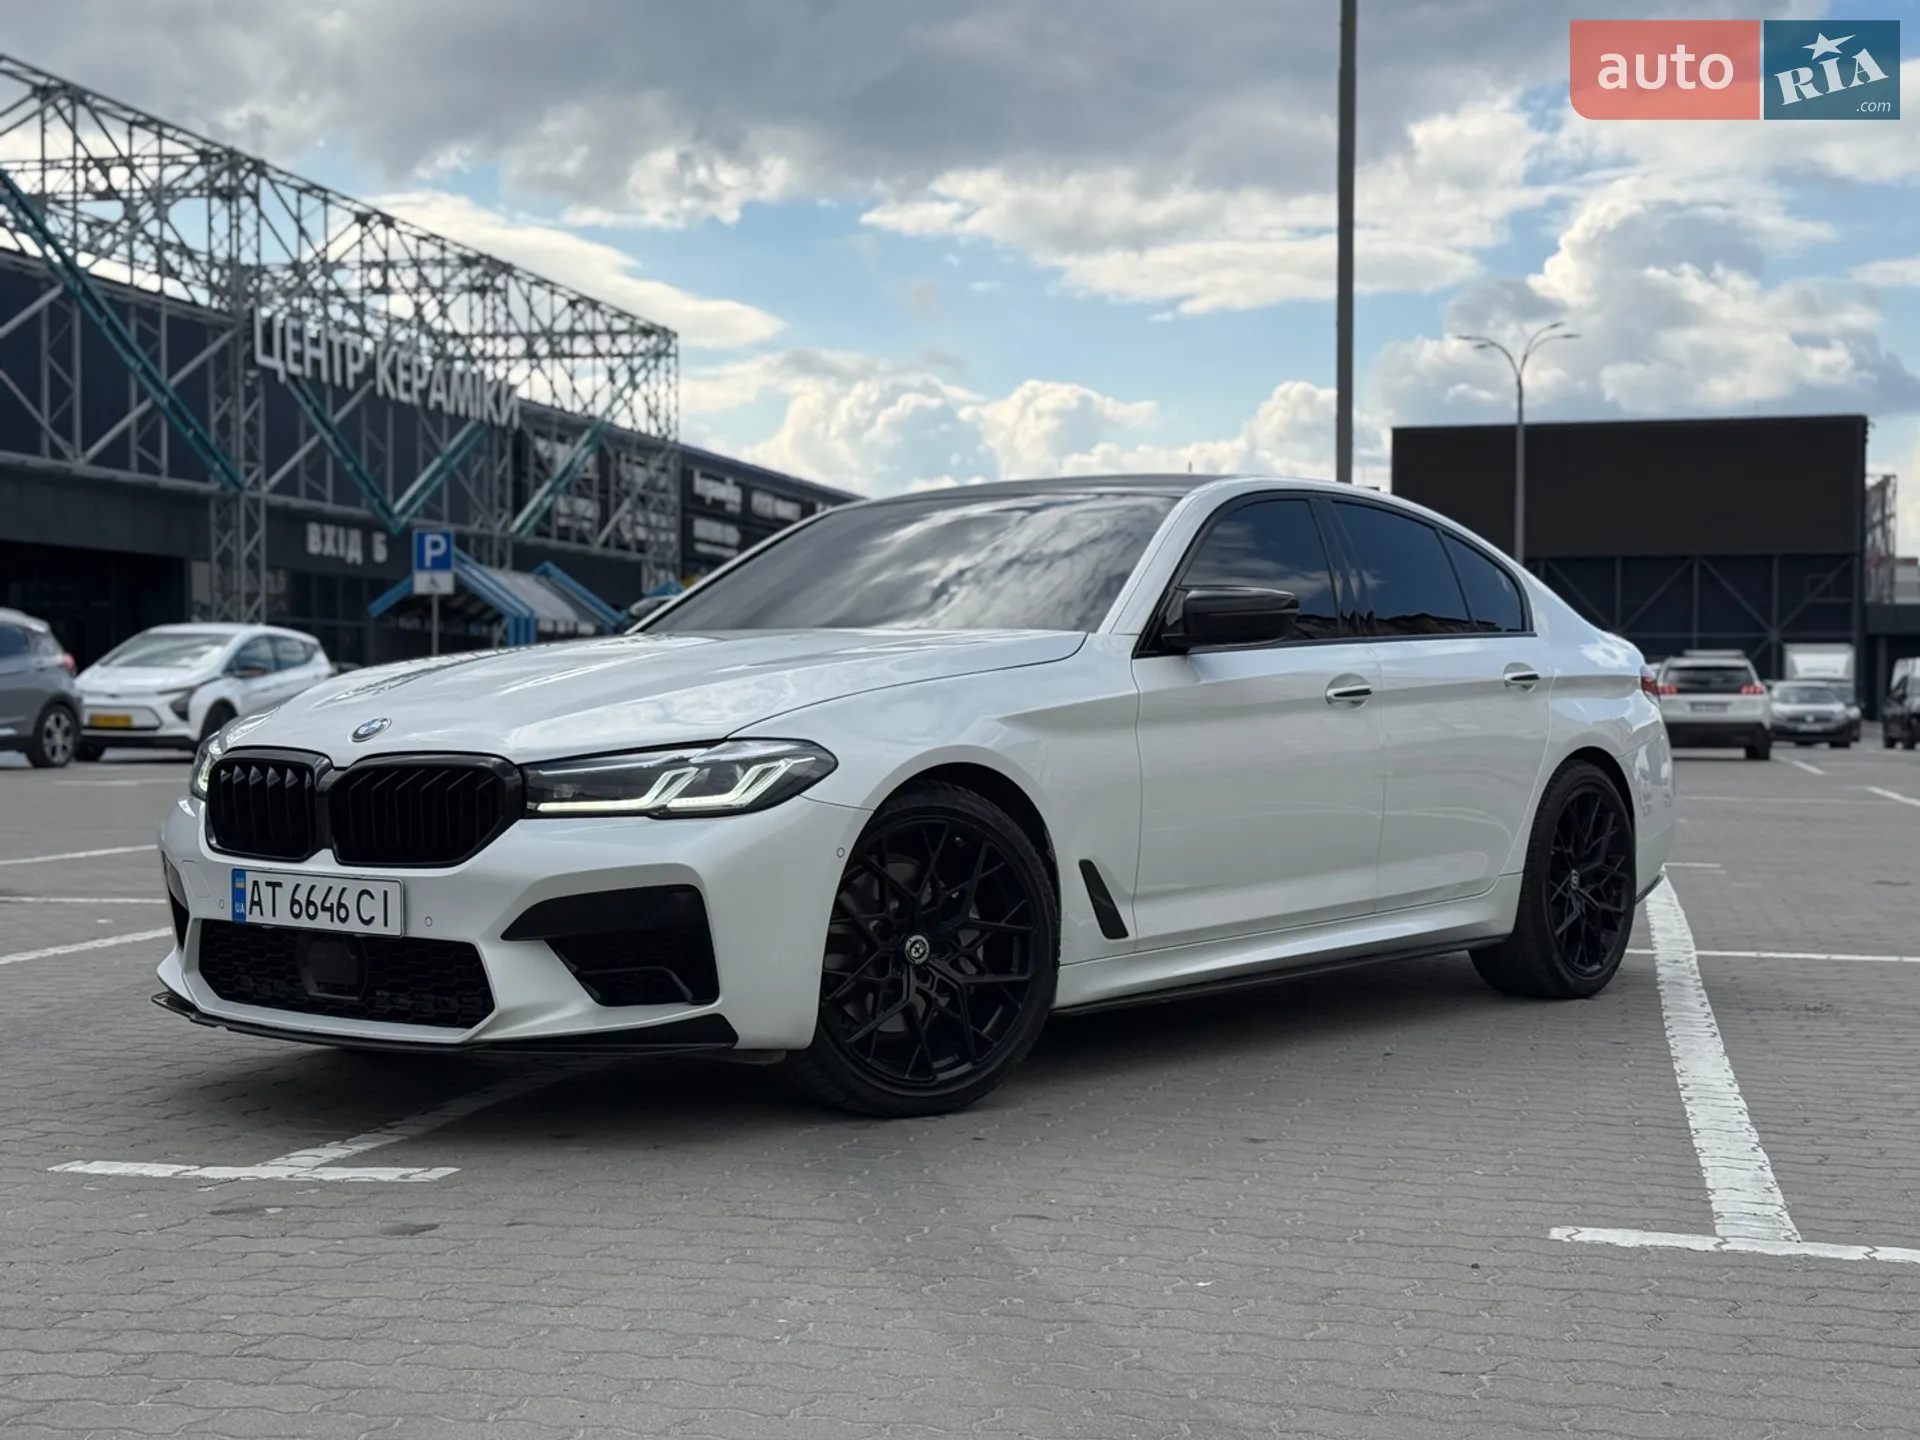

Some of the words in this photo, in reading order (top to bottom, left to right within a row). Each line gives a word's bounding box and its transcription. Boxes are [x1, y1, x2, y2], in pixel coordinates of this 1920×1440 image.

[254, 302, 366, 391] ЦЕНТР
[375, 343, 520, 429] КЕРАМІКИ
[306, 521, 363, 566] ВХІД
[423, 534, 448, 569] P
[235, 902, 245, 913] UA
[249, 880, 283, 917] AT
[289, 882, 350, 924] 6646
[356, 888, 388, 927] CI
